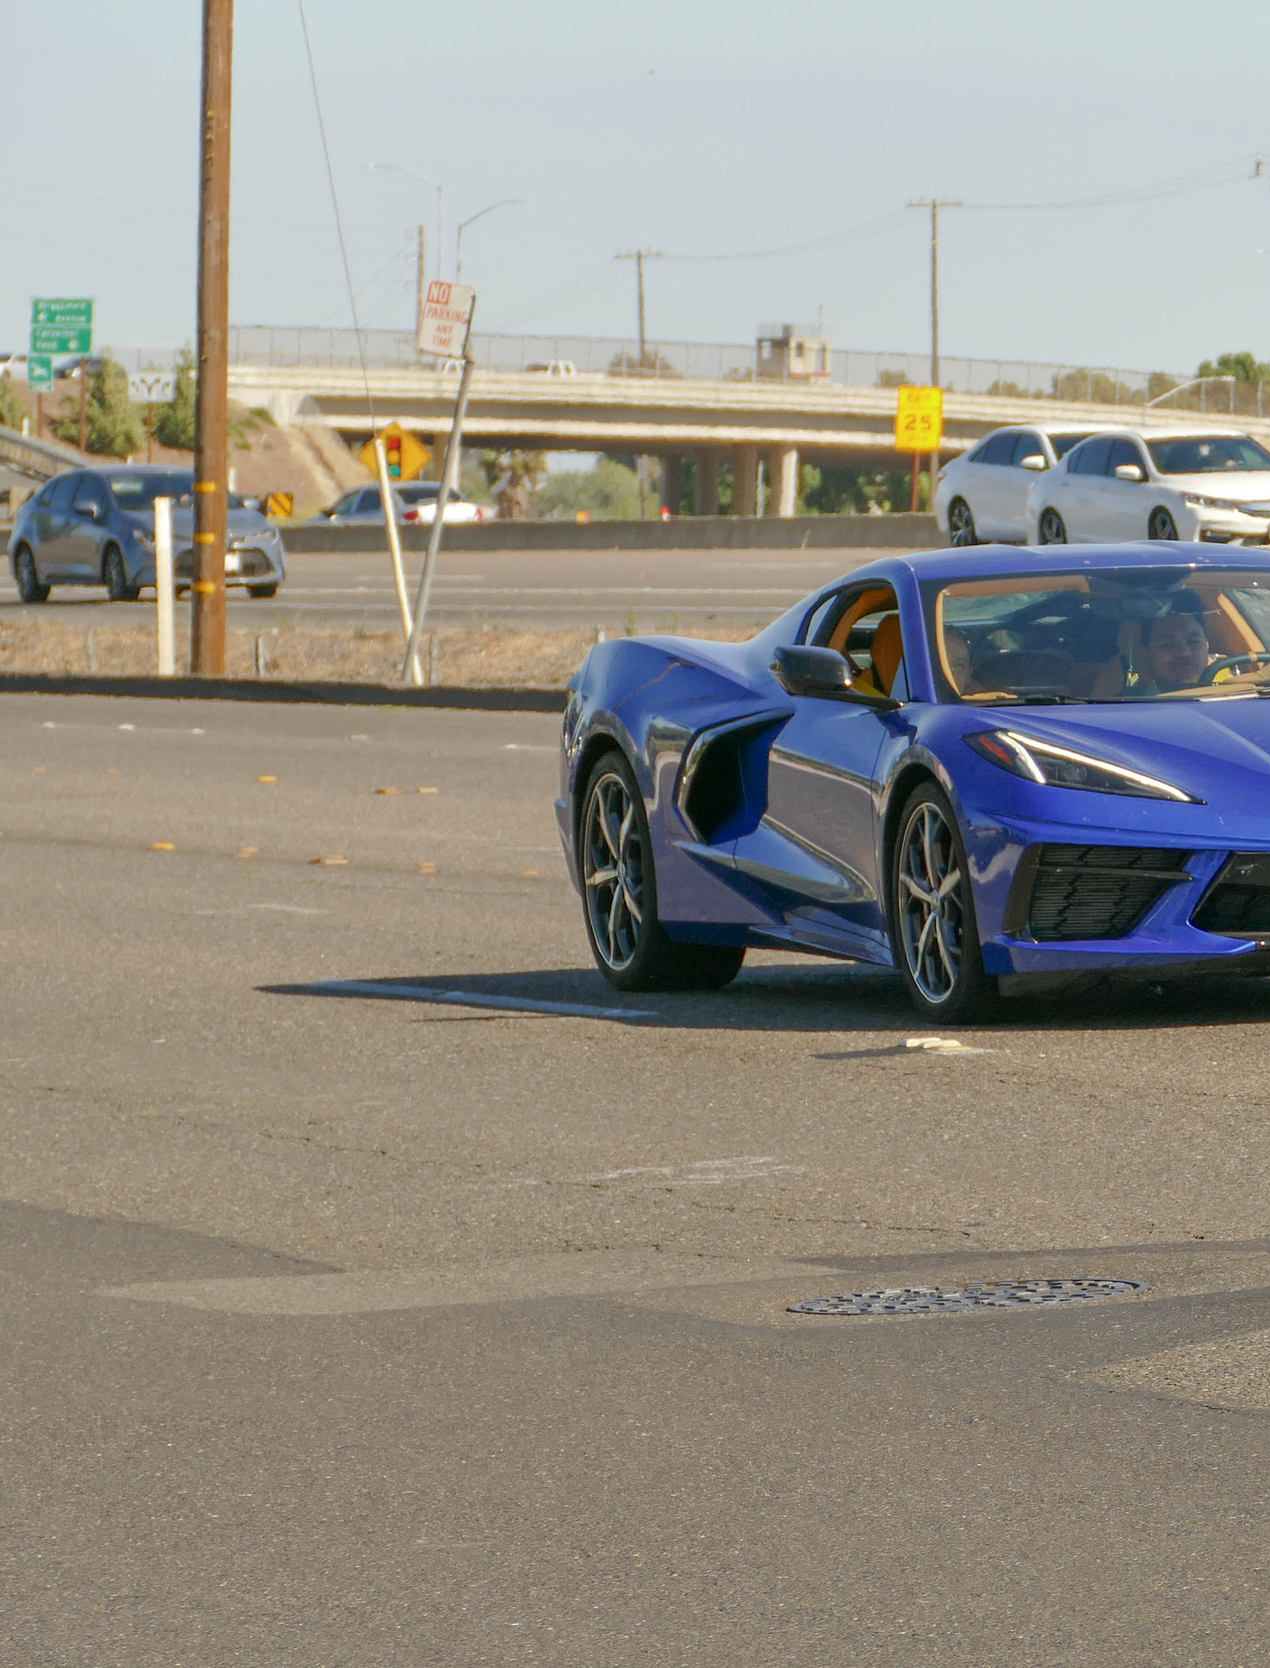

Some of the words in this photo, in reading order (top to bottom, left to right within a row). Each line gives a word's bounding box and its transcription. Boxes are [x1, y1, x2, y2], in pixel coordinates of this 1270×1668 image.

[429, 283, 450, 303] NO
[426, 305, 468, 324] PARKING
[436, 324, 454, 335] ANY
[433, 335, 453, 348] TIME
[904, 414, 932, 430] 25
